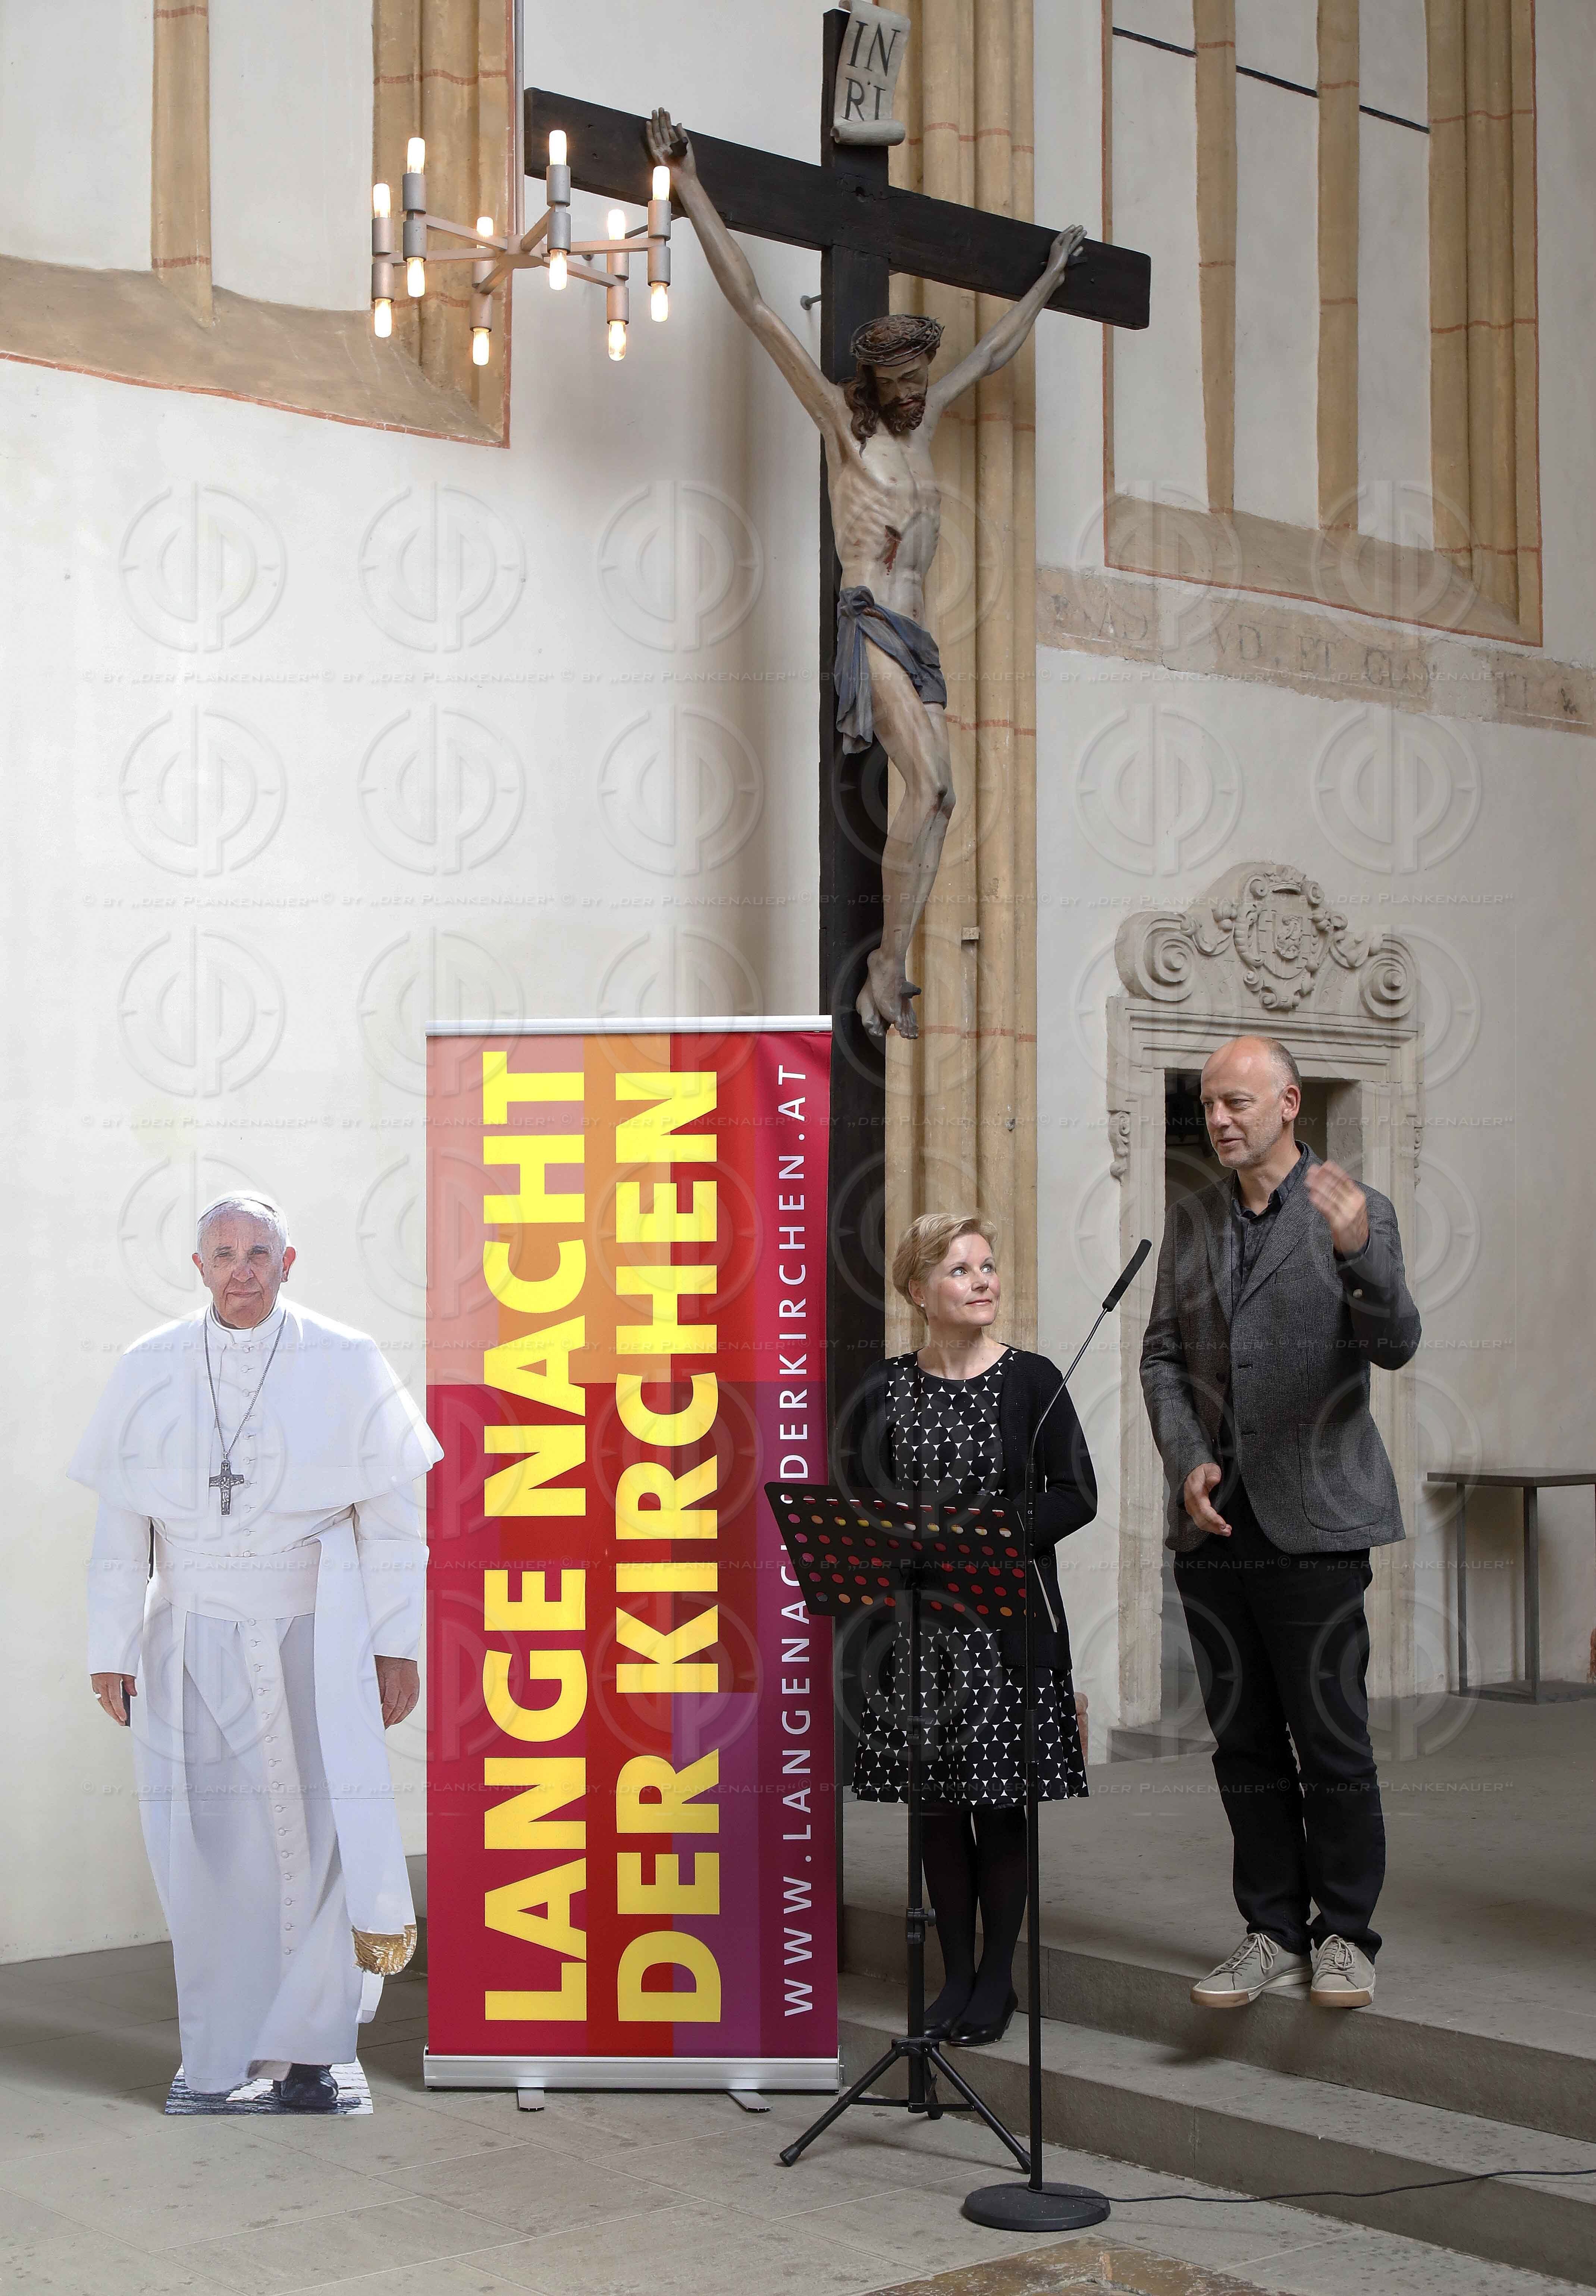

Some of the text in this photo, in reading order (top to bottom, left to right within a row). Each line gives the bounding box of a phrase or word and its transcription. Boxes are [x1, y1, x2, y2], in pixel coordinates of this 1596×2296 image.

[844, 21, 901, 77] IN
[483, 1051, 587, 2020] LANGE NACHT
[615, 1071, 721, 2022] DER KIRCHEN
[778, 1065, 812, 2017] WWW.LANGENACDERKIRCHEN.AT
